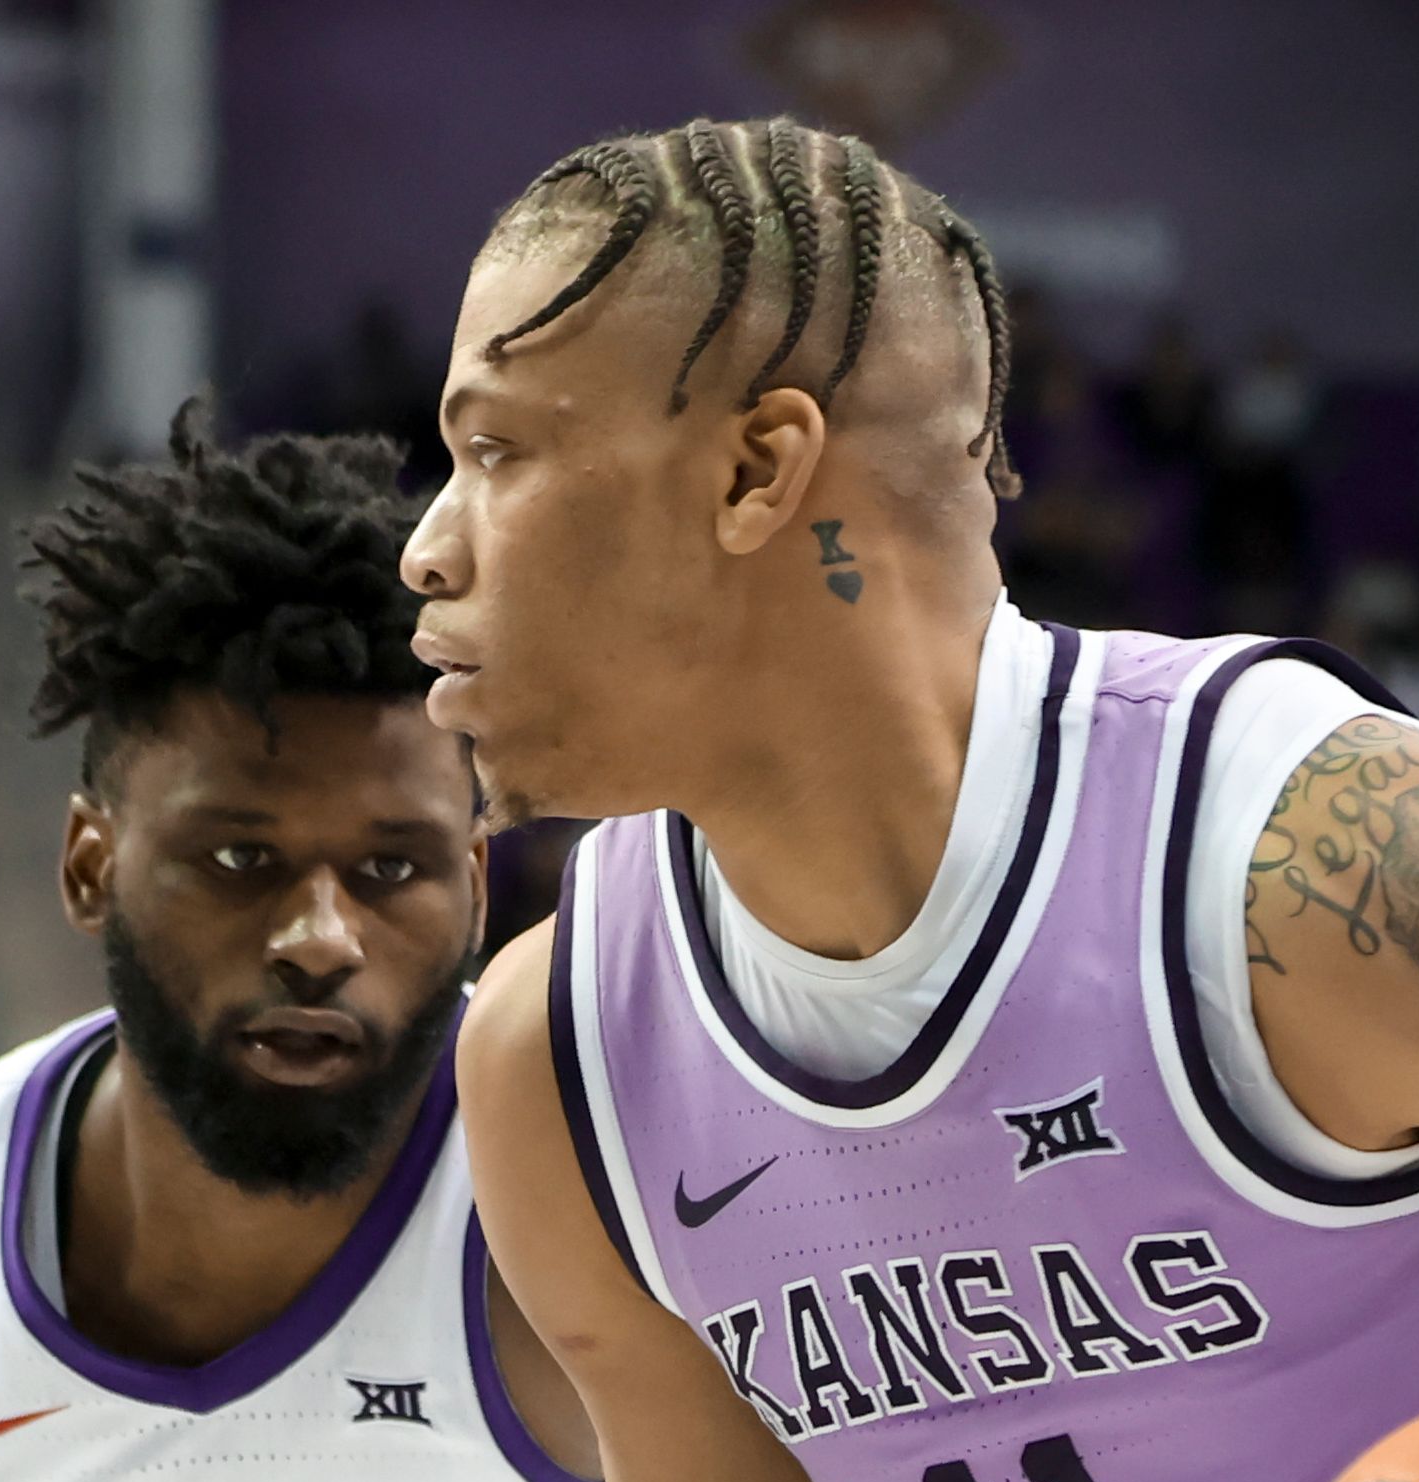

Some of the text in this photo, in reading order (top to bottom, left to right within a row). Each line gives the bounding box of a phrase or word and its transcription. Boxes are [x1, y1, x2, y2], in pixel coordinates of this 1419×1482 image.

[998, 1083, 1121, 1177] XII
[701, 1230, 1270, 1444] KANSAS
[344, 1377, 434, 1428] XII
